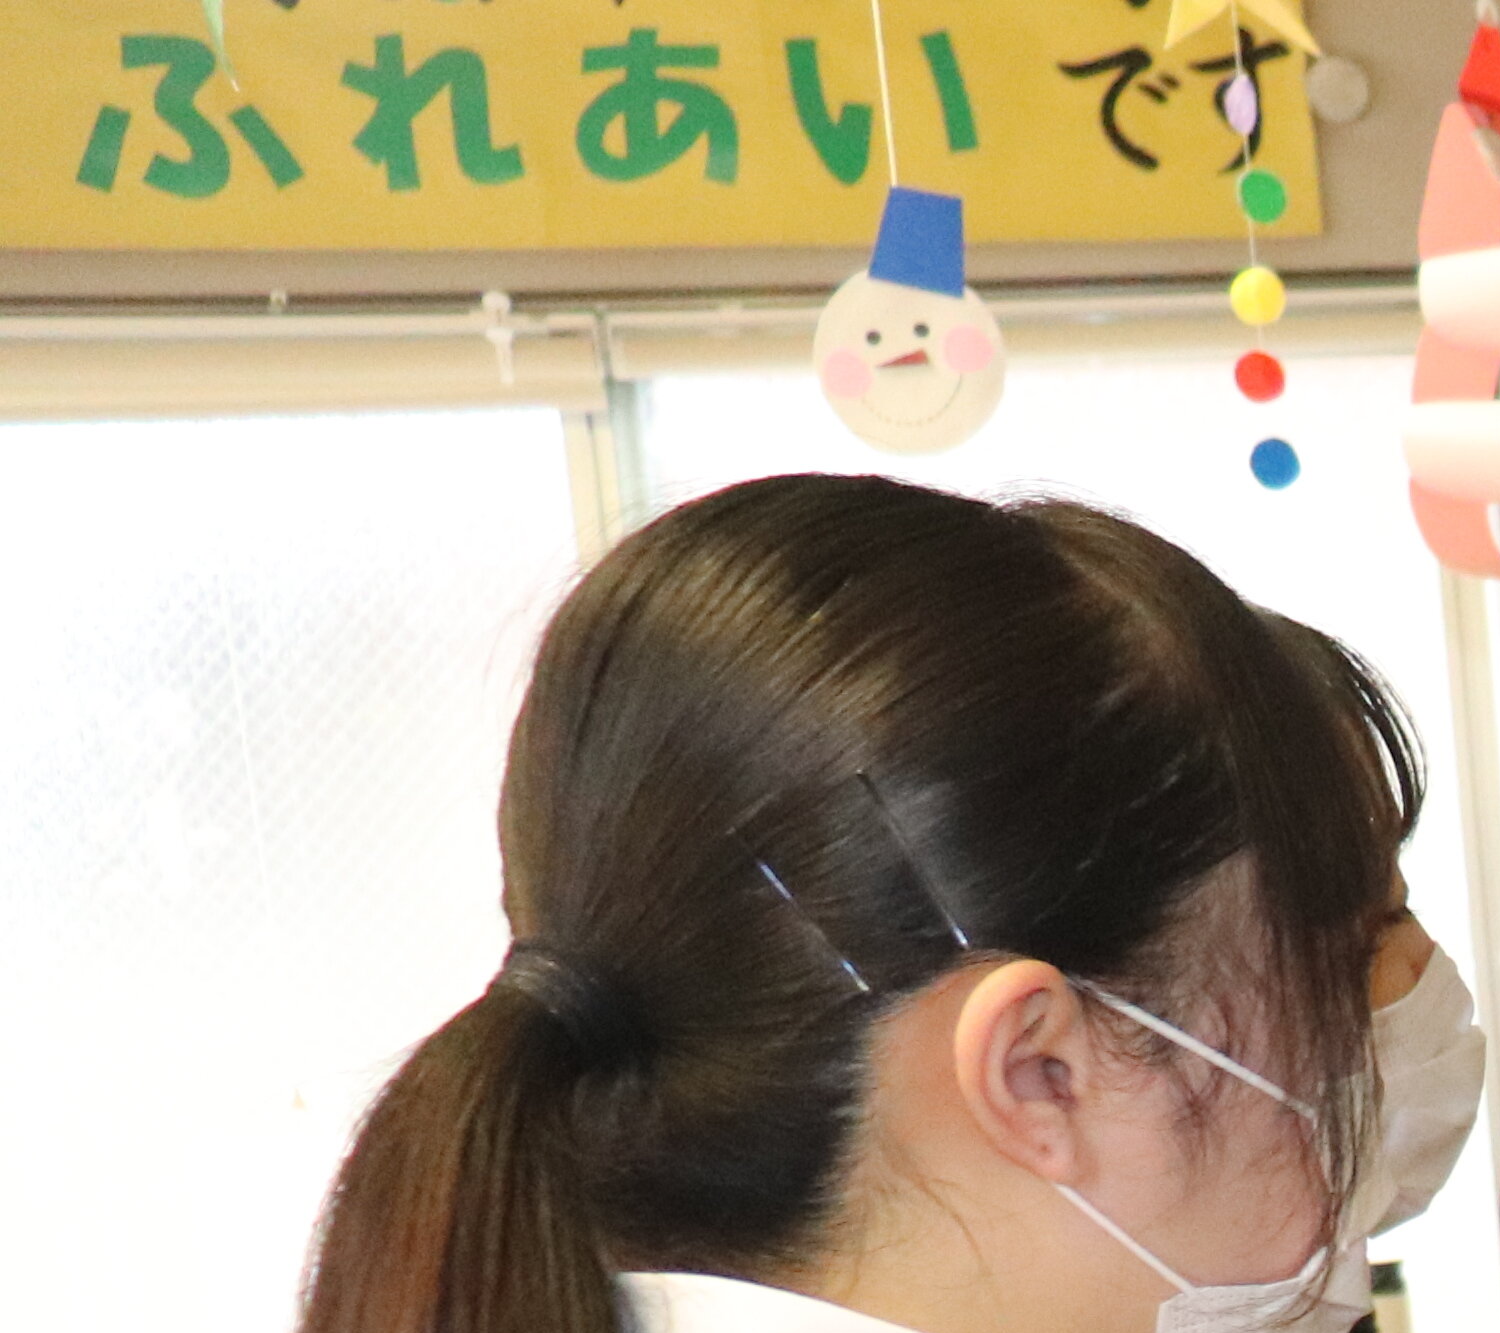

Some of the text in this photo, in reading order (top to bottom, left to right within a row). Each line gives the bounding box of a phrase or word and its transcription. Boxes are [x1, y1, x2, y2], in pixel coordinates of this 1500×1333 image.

[76, 30, 1291, 201] ふれあい です
